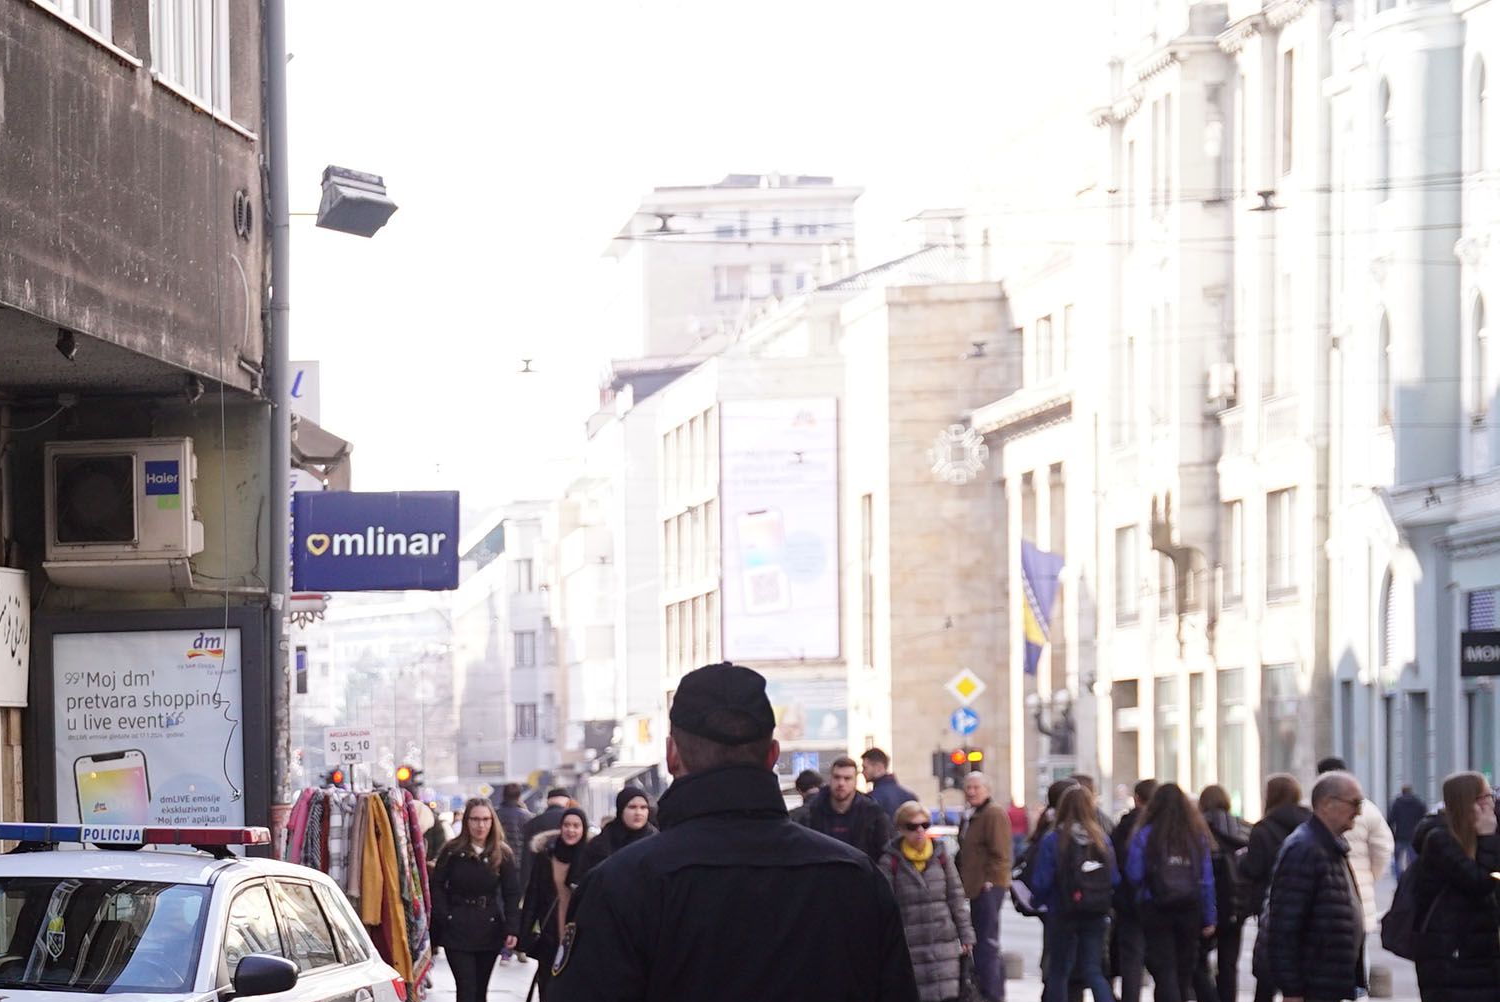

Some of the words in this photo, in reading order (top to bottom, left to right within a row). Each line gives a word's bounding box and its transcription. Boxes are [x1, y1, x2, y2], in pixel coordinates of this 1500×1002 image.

[146, 472, 179, 484] Haier
[332, 526, 447, 556] mlinar
[193, 632, 221, 649] dm
[67, 694, 137, 712] pretvara
[143, 689, 222, 710] shopping
[68, 718, 77, 731] u
[84, 714, 112, 730] live
[357, 740, 370, 750] 10
[344, 753, 357, 761] KM
[84, 828, 140, 841] POLICIJA
